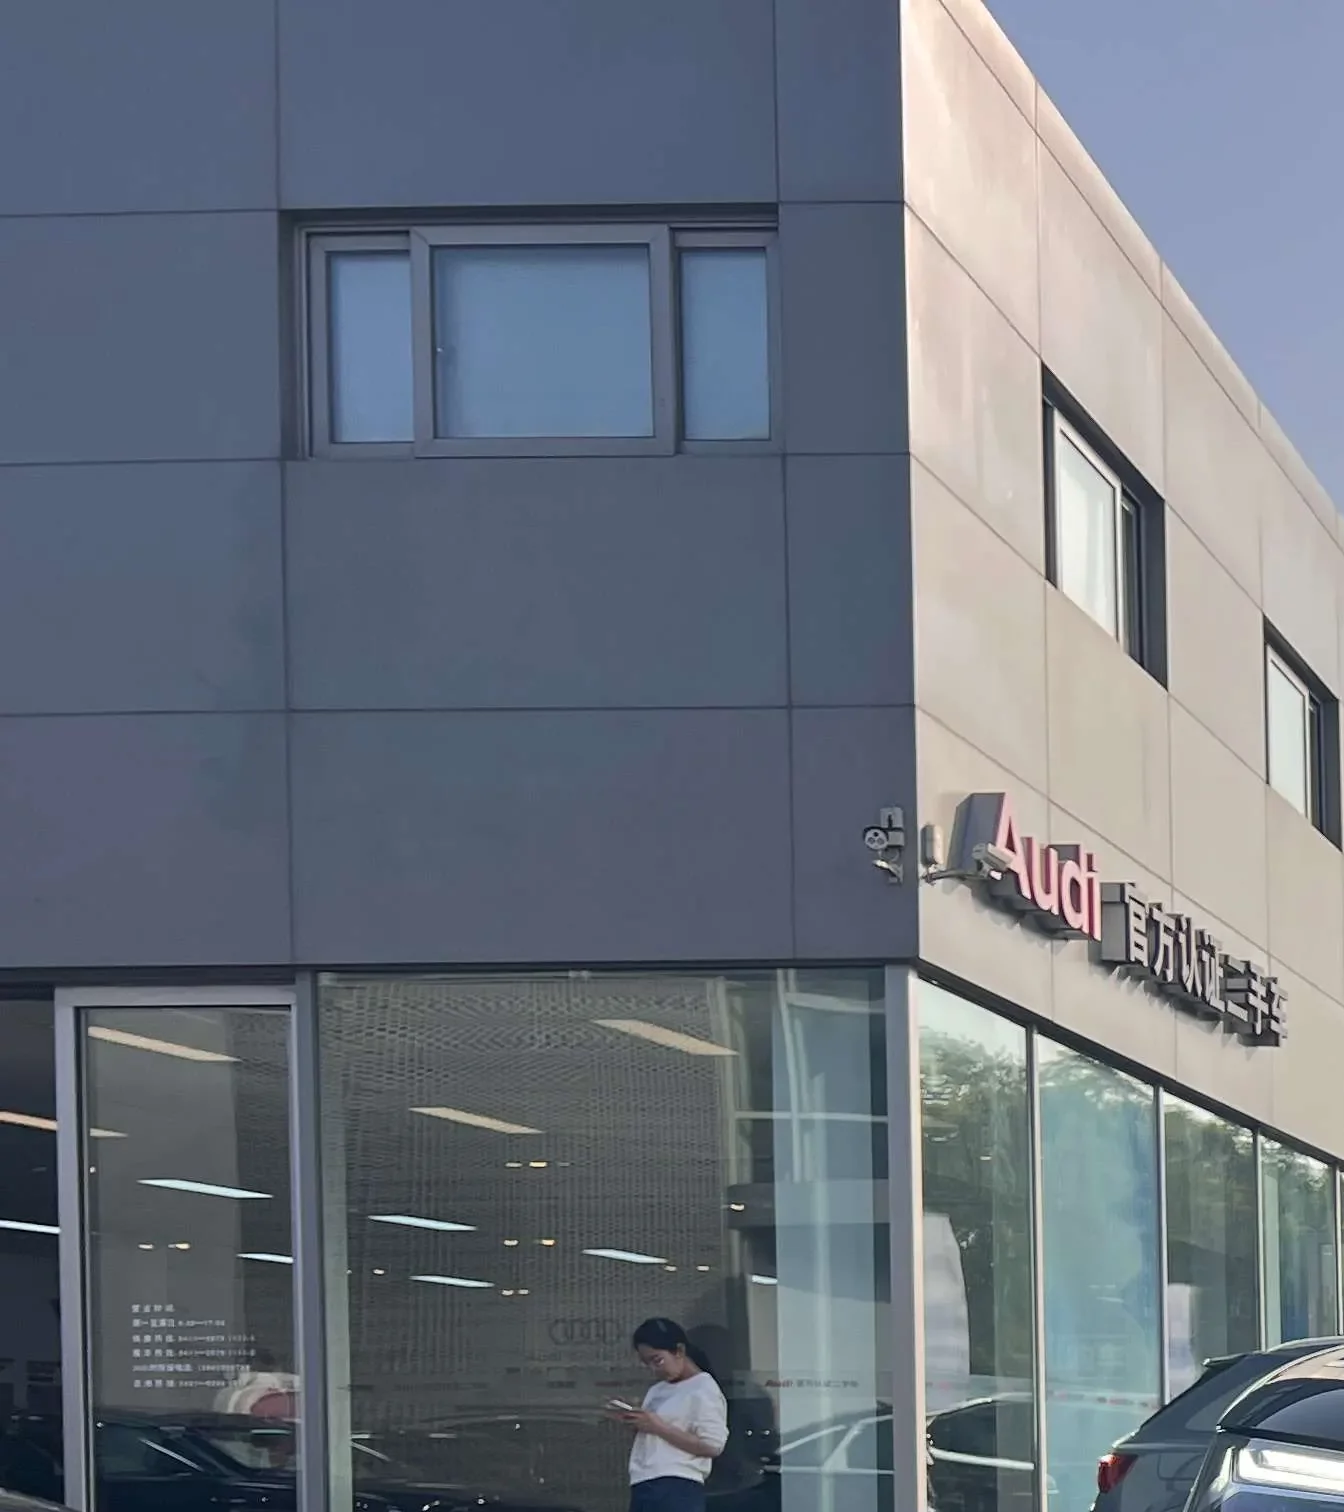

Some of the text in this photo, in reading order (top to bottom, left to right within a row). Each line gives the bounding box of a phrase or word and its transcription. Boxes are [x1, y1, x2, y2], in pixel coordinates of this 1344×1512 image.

[994, 792, 1288, 1048] Audi 官方认证二手车
